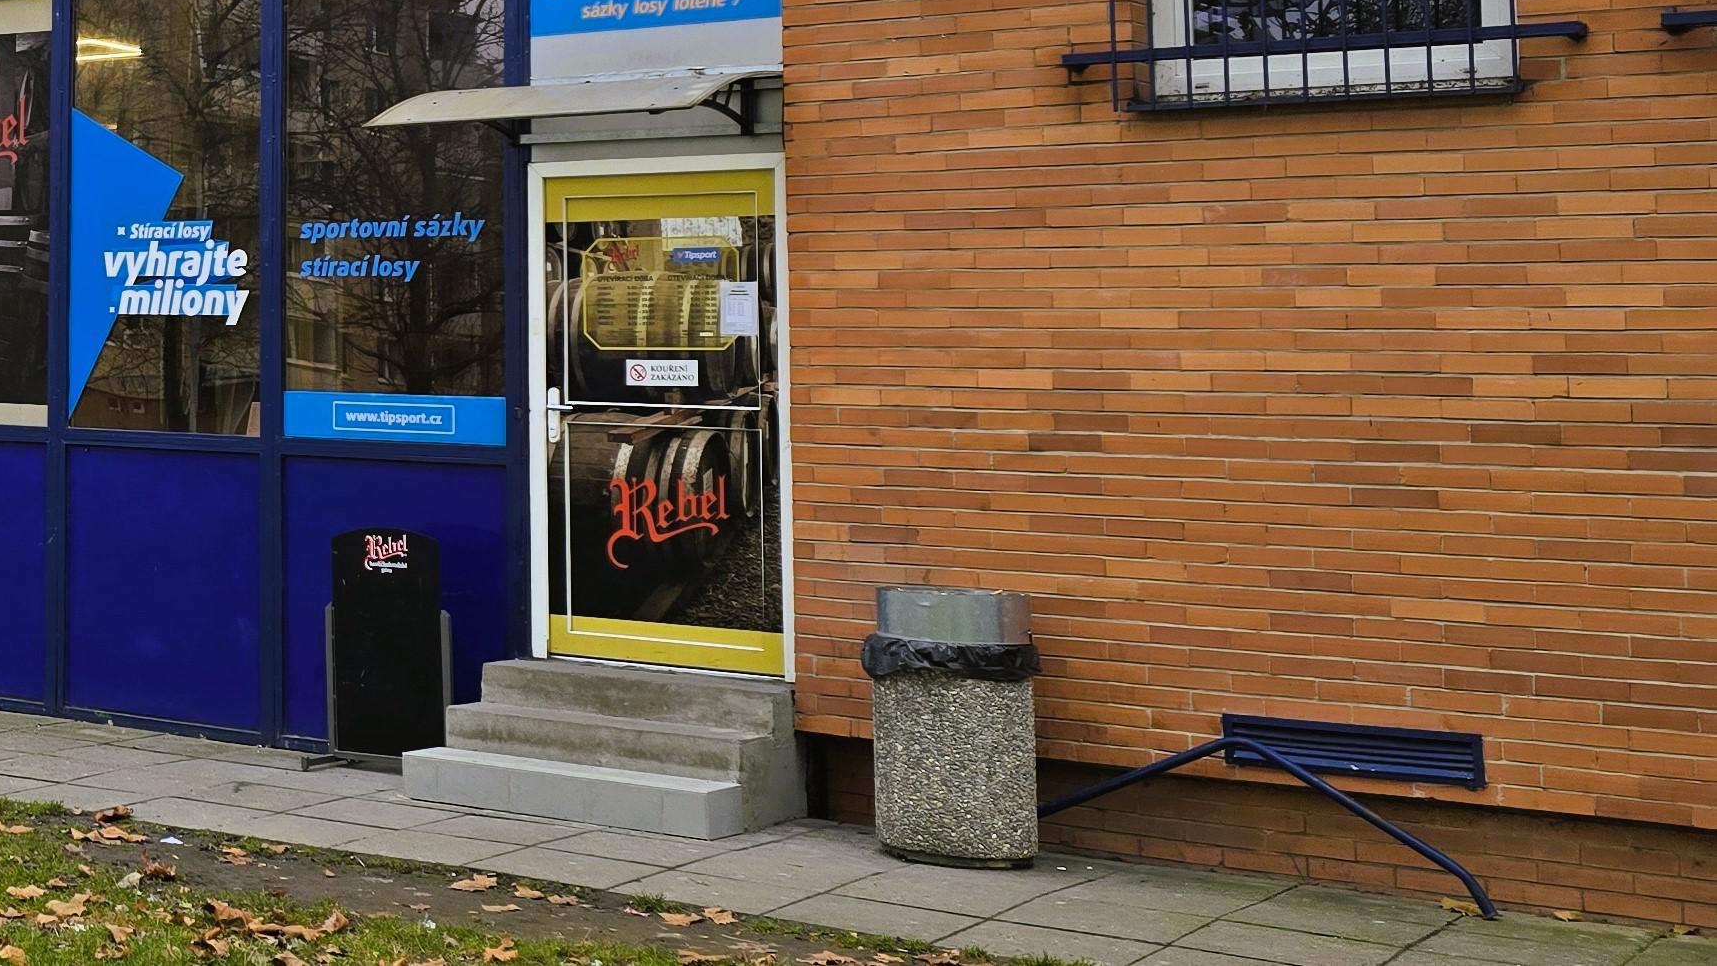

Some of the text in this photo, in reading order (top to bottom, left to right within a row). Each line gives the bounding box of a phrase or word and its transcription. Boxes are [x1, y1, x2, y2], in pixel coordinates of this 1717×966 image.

[582, 0, 628, 20] sázky
[129, 221, 212, 241] Stírací losy
[300, 212, 485, 244] sportovní sázky
[103, 239, 249, 286] vyhrajte
[684, 250, 717, 260] Tipsport
[300, 254, 421, 283] stírací losy
[650, 364, 688, 373] KOUŘENÍ
[345, 410, 443, 426] www.tipsport.cz
[606, 474, 731, 568] Rebel
[364, 534, 408, 570] Rebel
